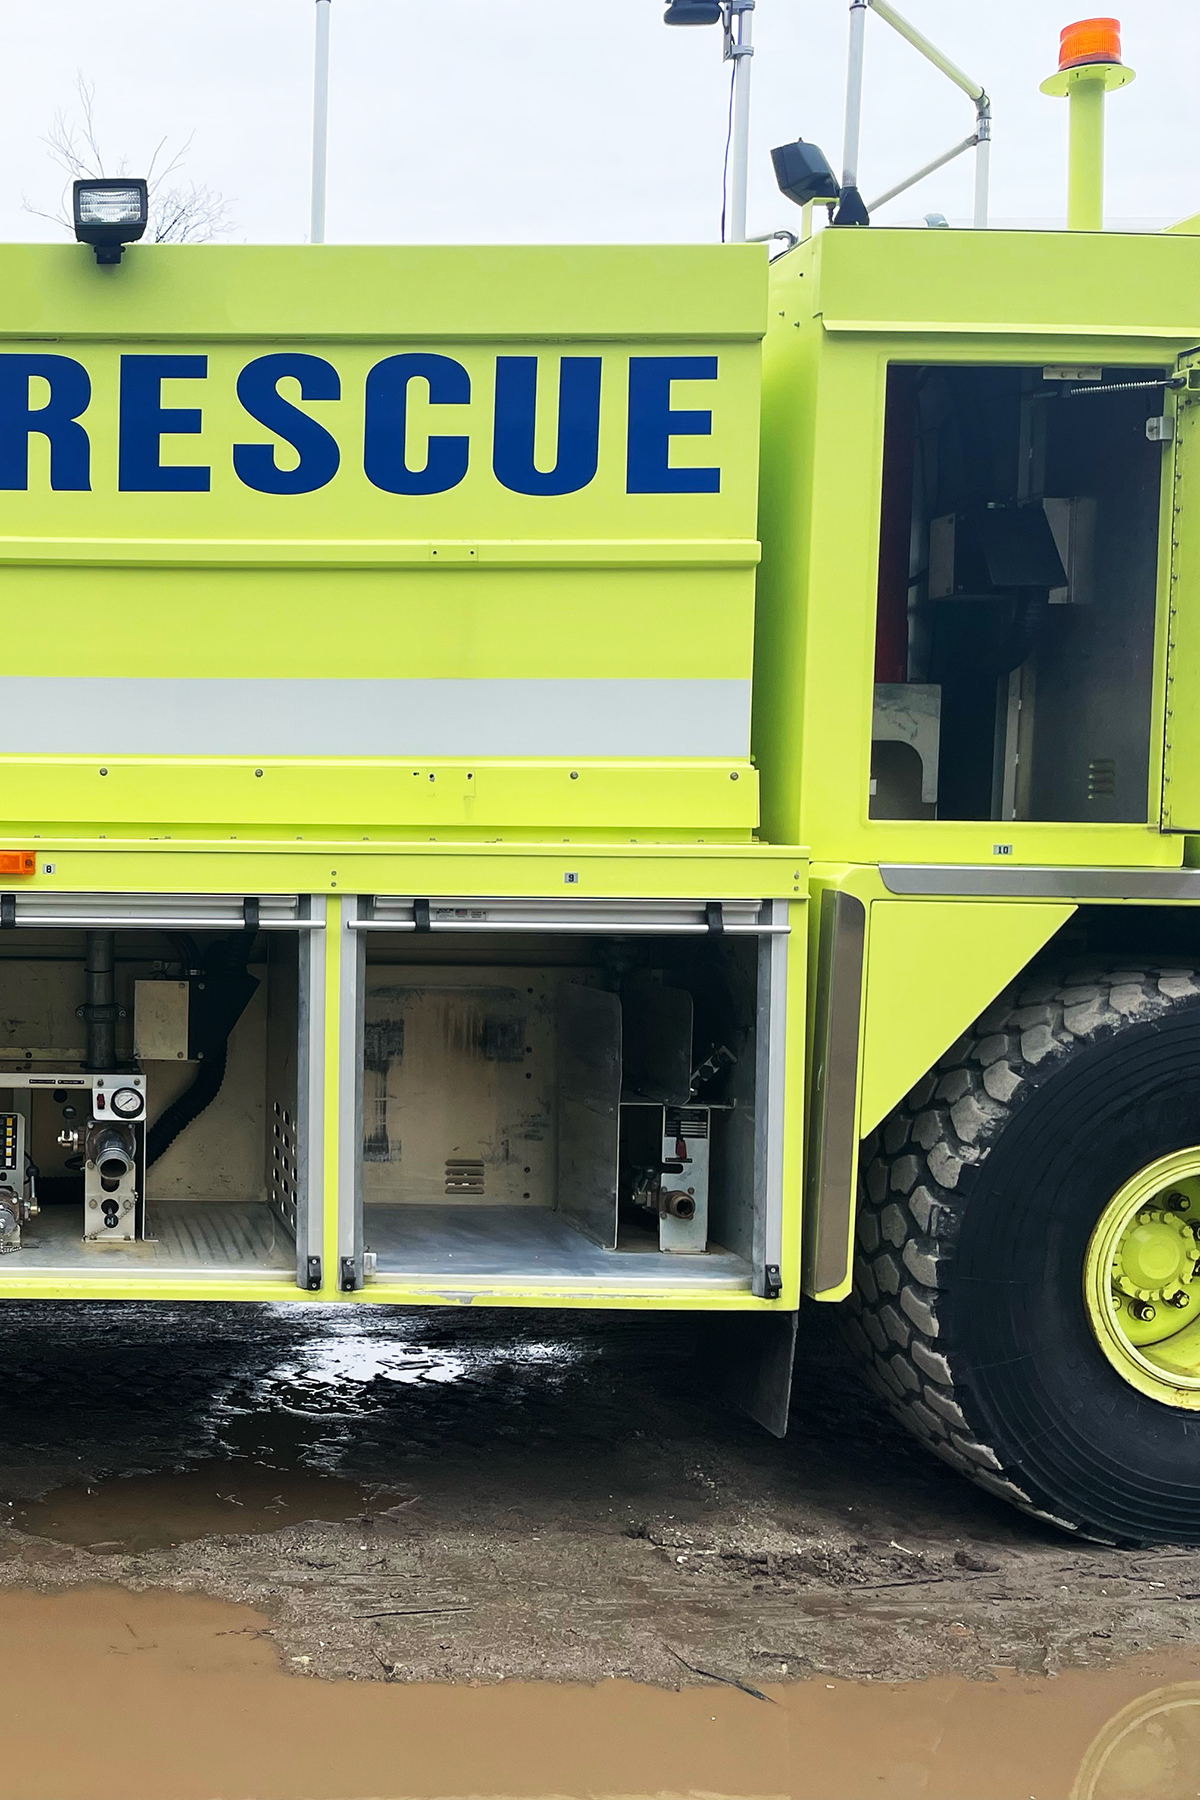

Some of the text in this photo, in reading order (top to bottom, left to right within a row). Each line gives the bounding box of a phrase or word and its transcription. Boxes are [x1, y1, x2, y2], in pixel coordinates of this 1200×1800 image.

[997, 846, 1009, 854] 10
[46, 865, 52, 873] 8
[568, 873, 574, 882] 9
